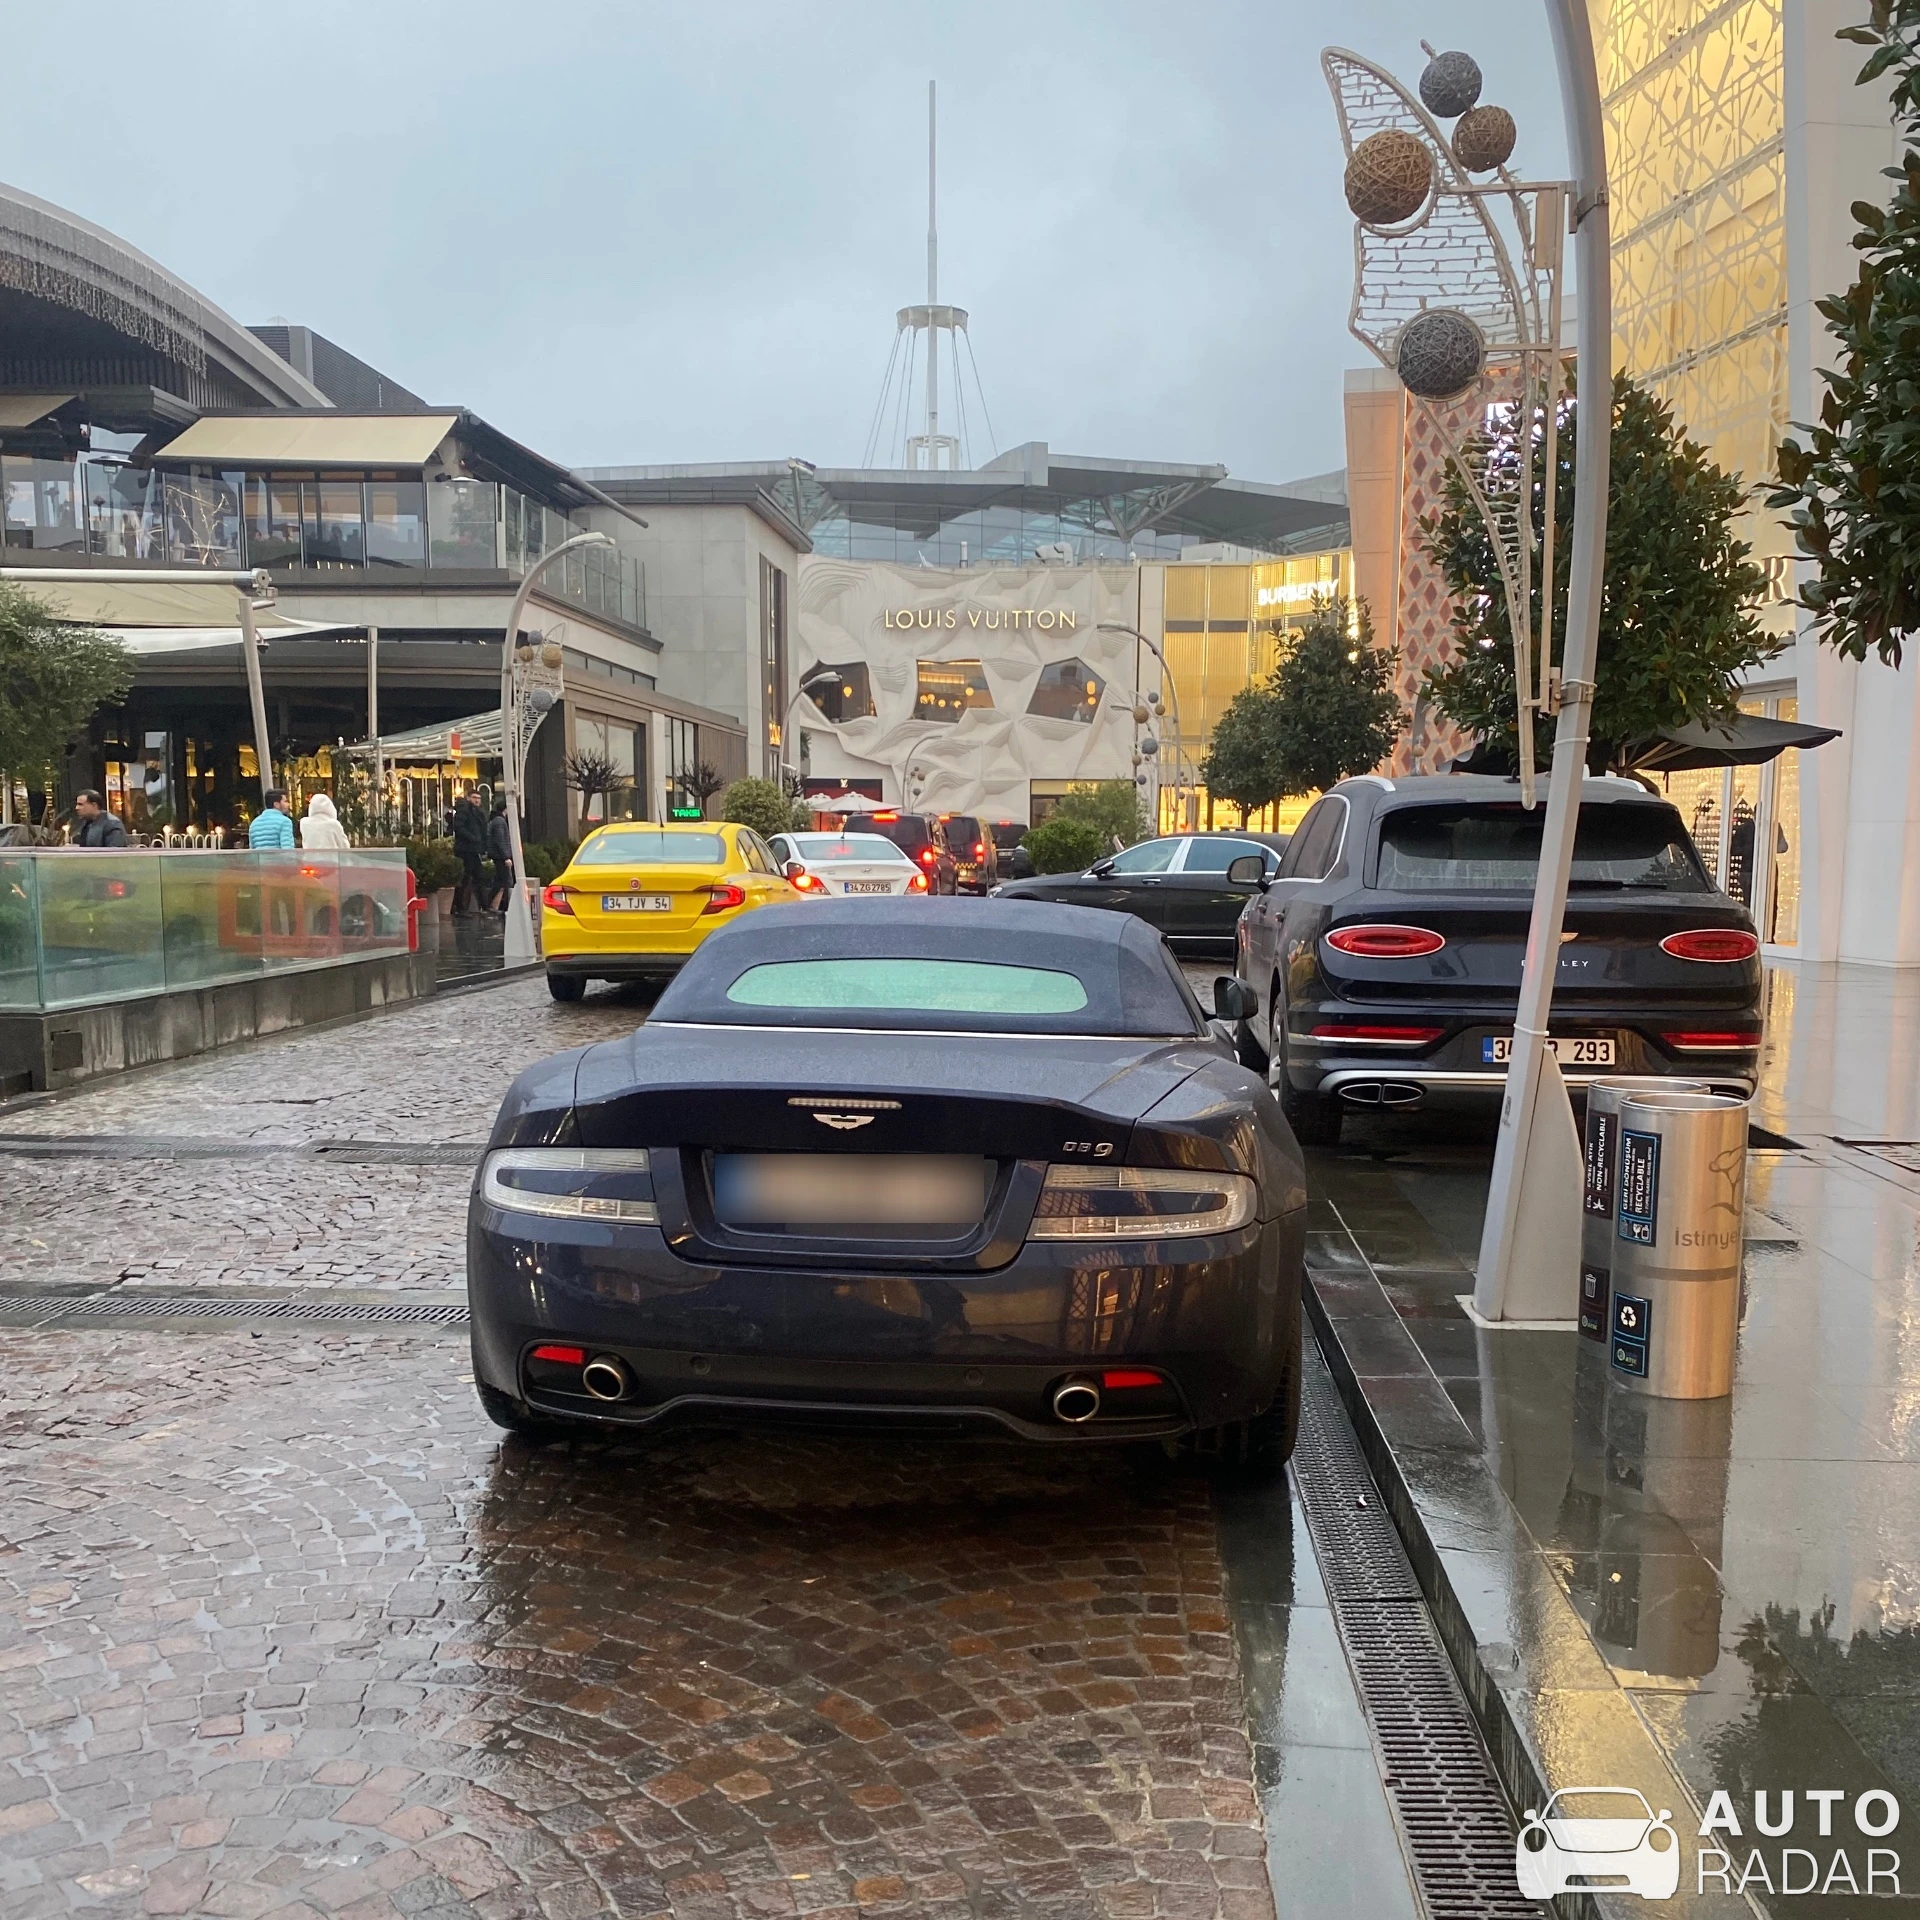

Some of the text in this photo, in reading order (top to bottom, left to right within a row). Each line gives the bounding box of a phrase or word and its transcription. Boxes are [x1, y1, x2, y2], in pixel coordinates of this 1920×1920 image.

[1258, 578, 1339, 606] BURBERRY
[885, 609, 1076, 629] LOUIS VUITTON
[850, 882, 891, 892] 34 ZG 2785
[609, 898, 621, 909] 34
[655, 898, 668, 909] 54
[1573, 1041, 1610, 1062] 293
[1062, 1141, 1114, 1157] DB9
[1596, 1117, 1607, 1191] NON-RECYCLABLE
[1634, 1158, 1646, 1213] RECYCLABLE
